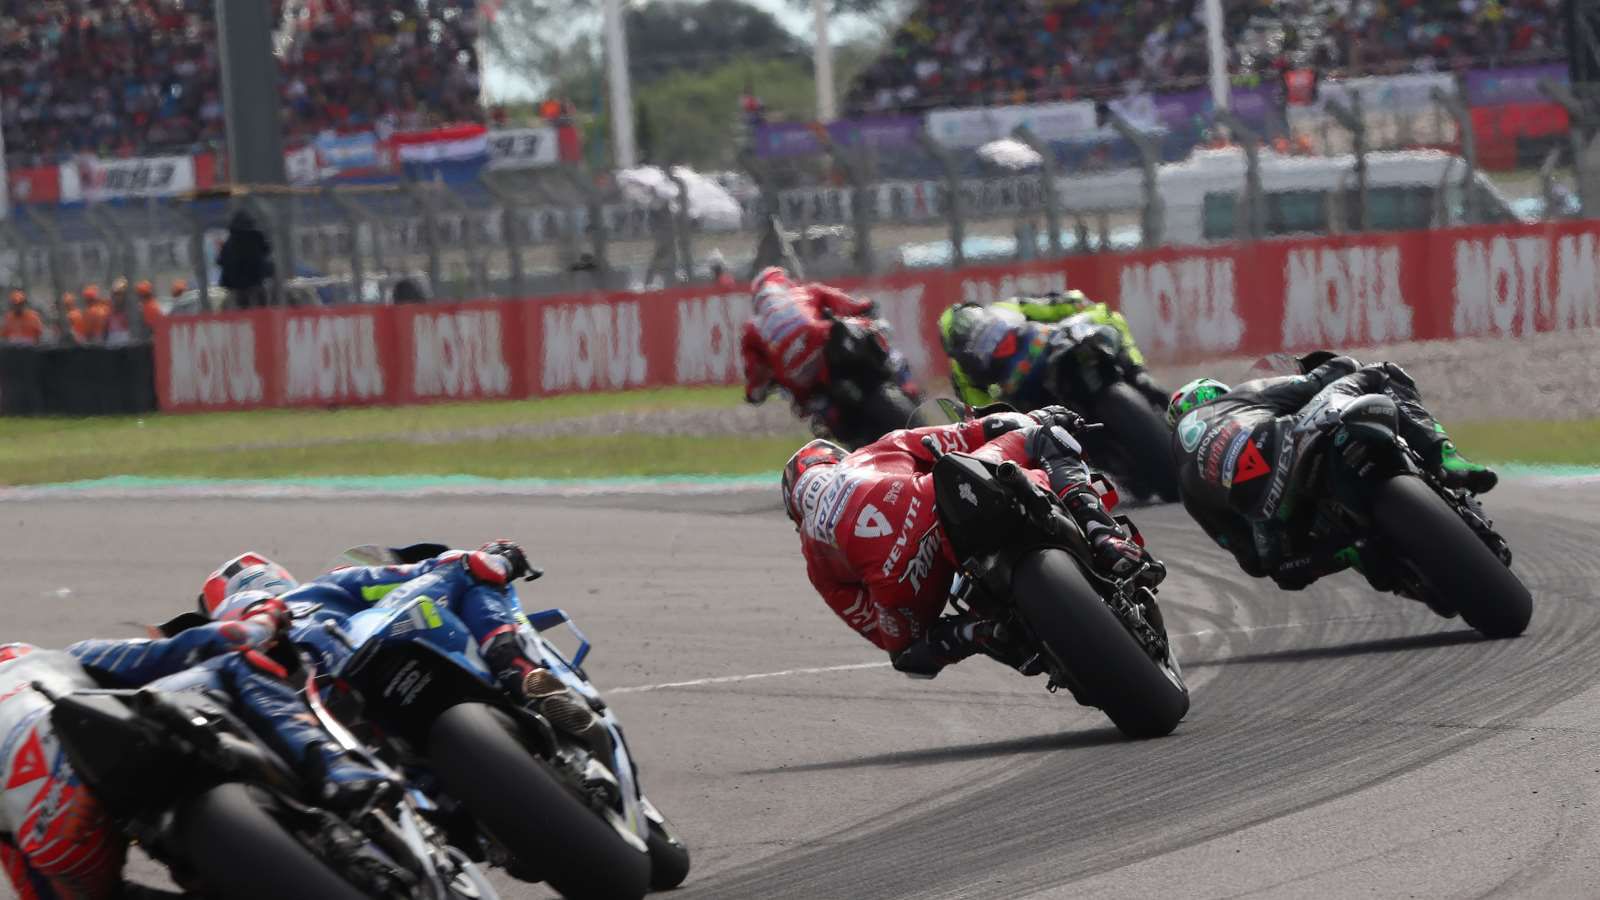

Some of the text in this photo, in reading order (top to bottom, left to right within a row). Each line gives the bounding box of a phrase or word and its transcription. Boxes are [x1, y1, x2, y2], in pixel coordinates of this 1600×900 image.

[169, 319, 263, 404] MOTUL
[284, 314, 385, 398] MOTUL
[412, 309, 510, 397] MOTUL
[541, 301, 647, 391] MOTUL
